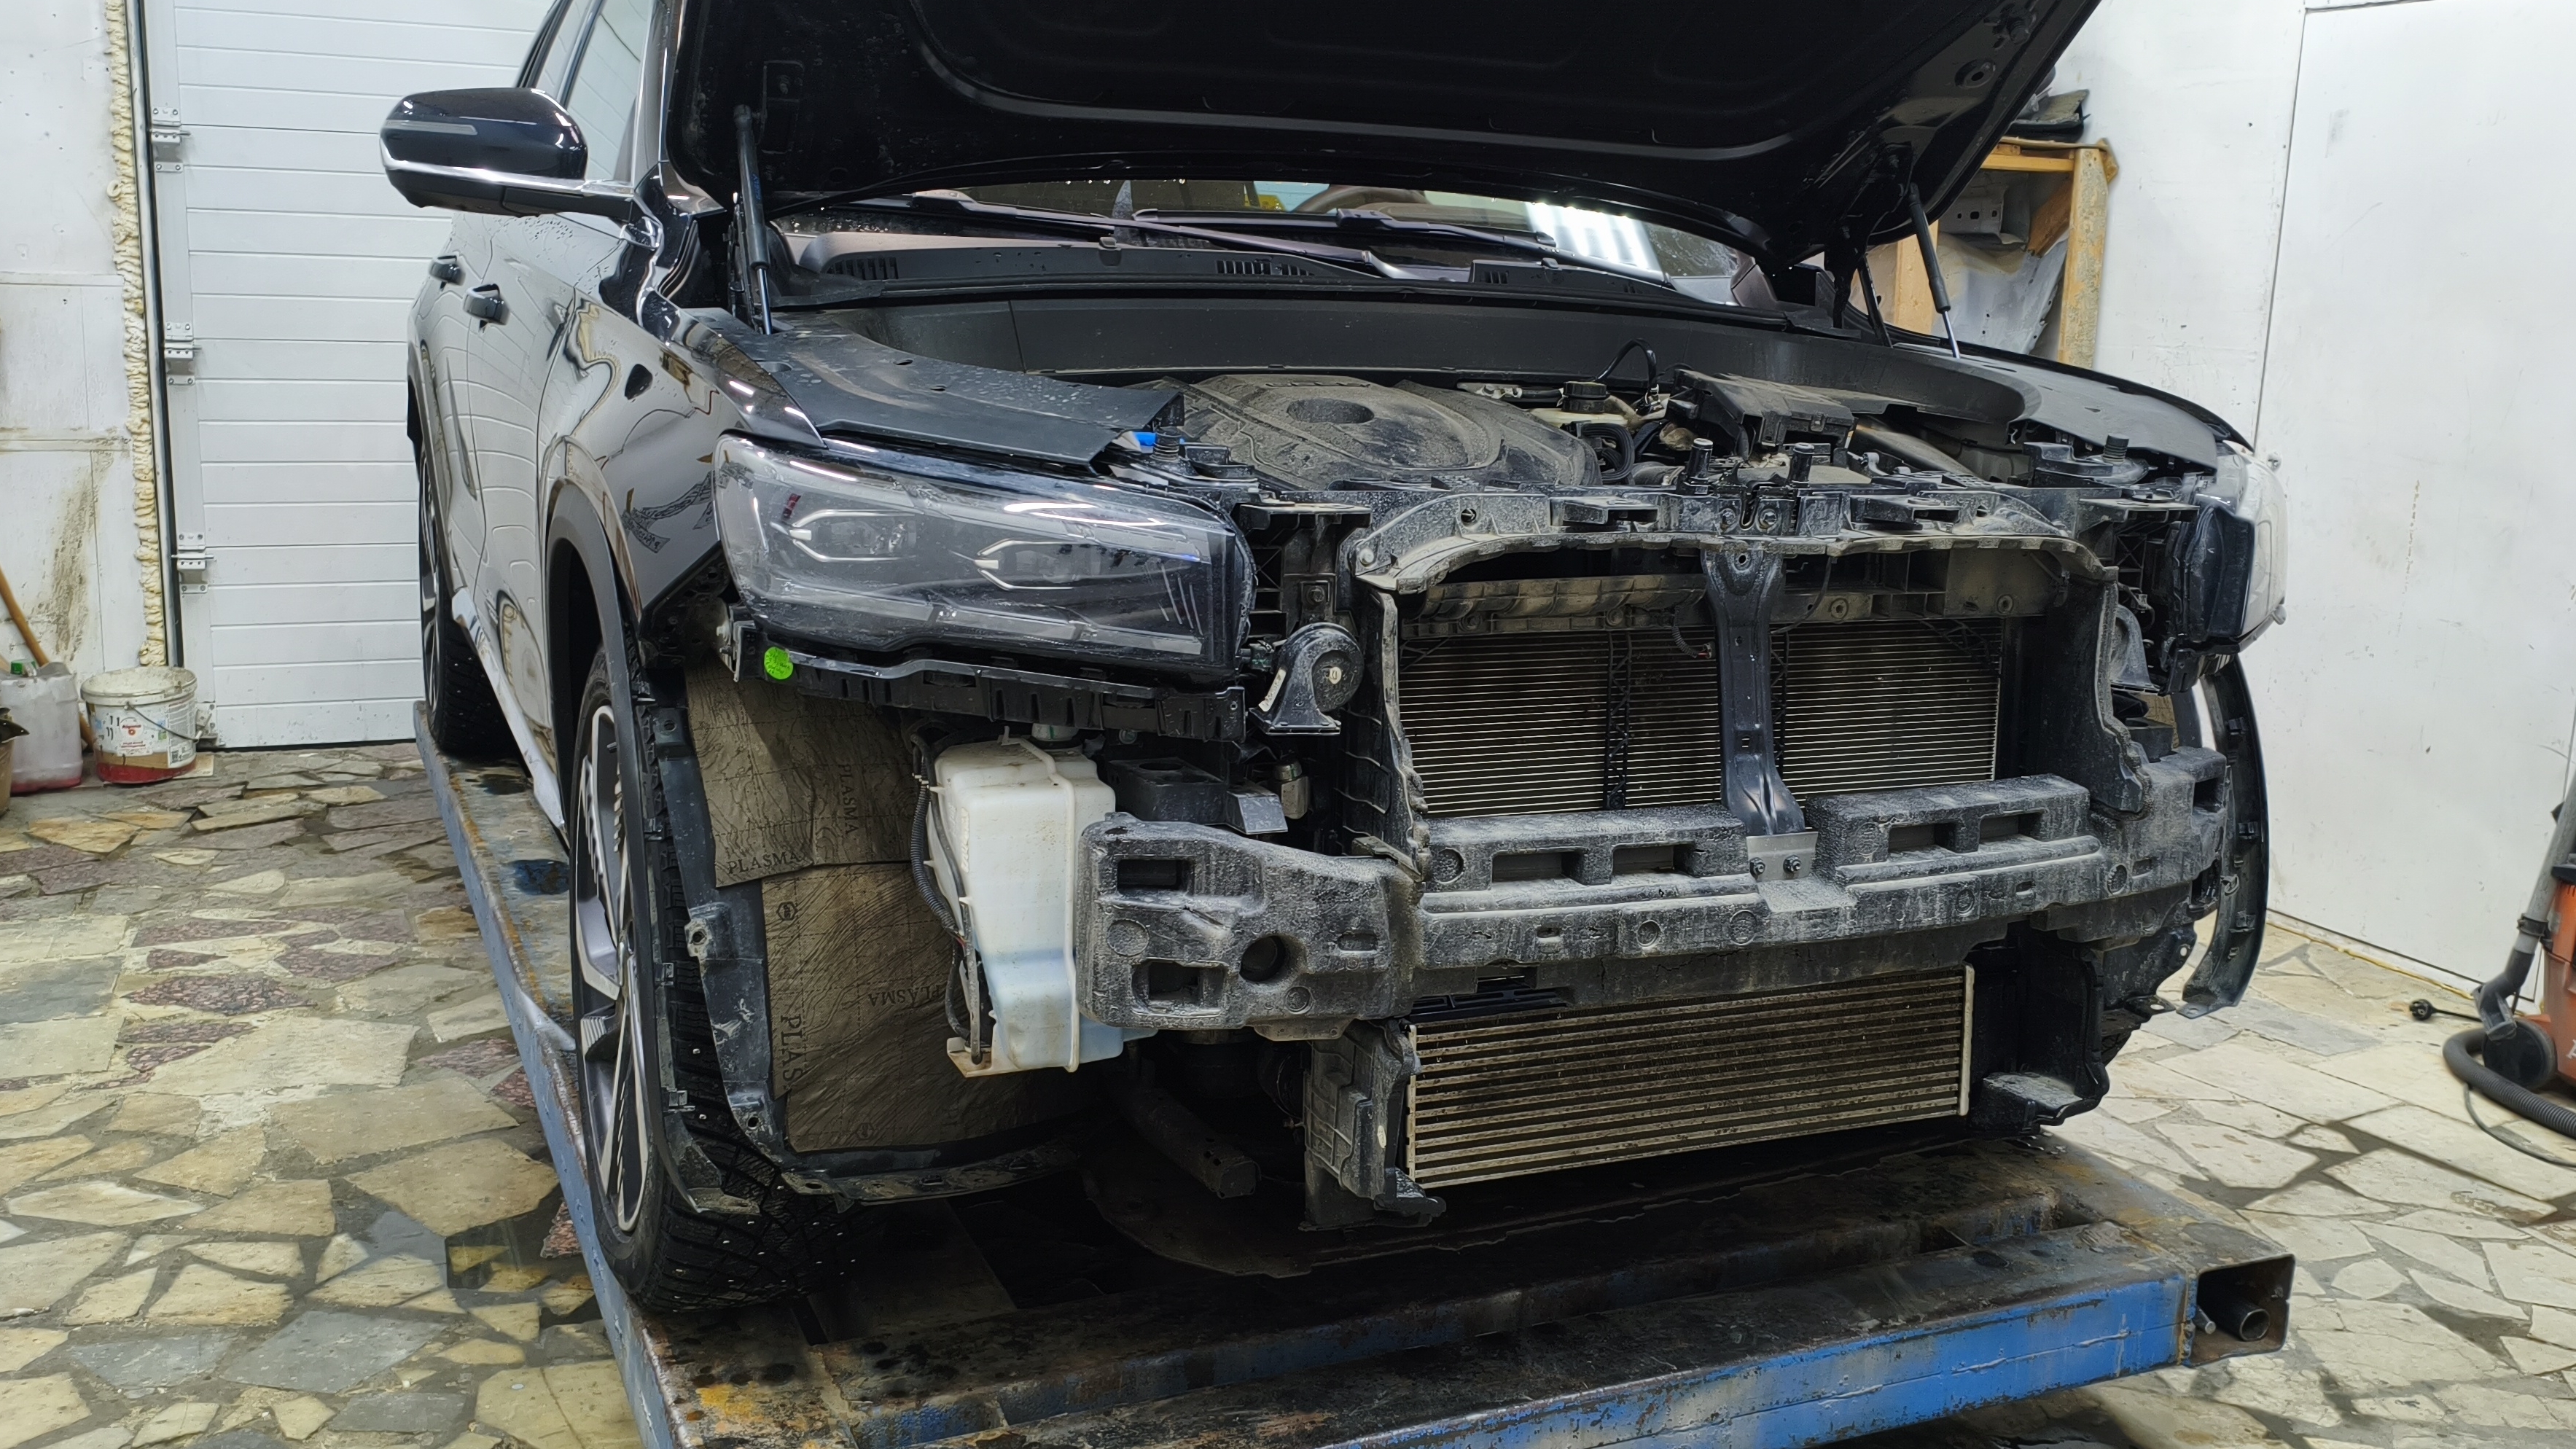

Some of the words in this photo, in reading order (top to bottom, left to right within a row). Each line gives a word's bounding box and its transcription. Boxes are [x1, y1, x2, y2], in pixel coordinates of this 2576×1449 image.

[838, 763, 859, 835] PLASMA
[727, 851, 802, 875] PLASMA
[867, 984, 941, 1007] PLASMA
[780, 1014, 803, 1085] PLAS
